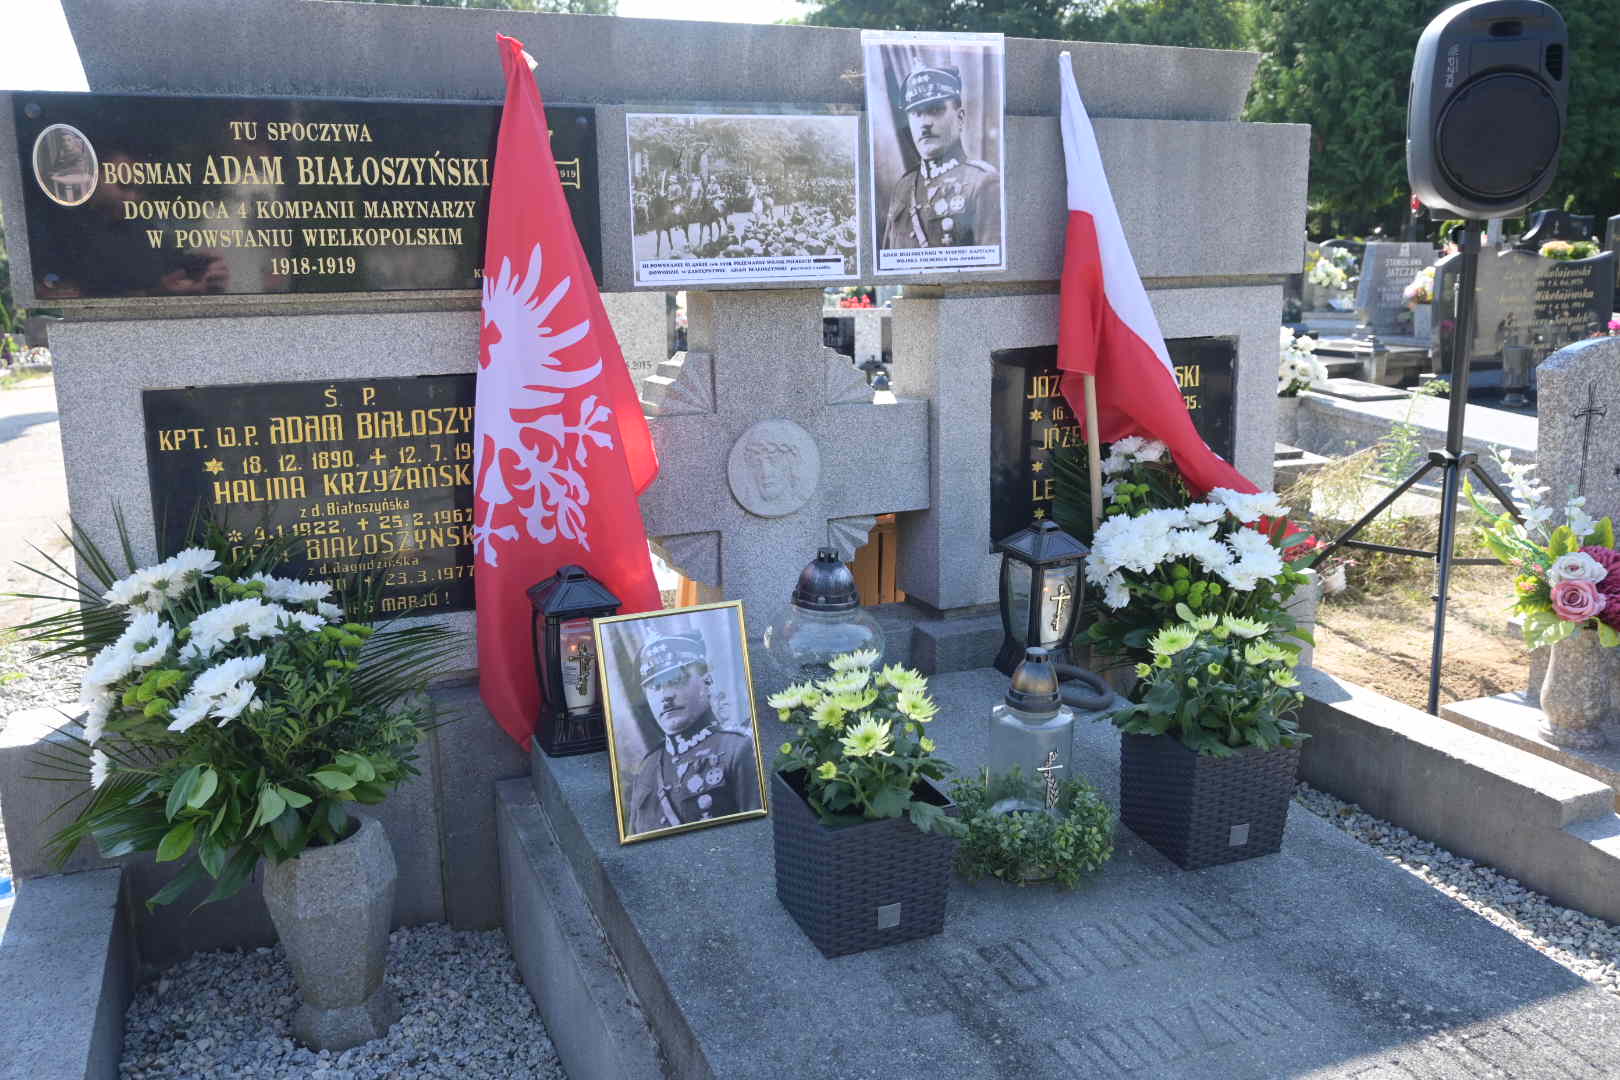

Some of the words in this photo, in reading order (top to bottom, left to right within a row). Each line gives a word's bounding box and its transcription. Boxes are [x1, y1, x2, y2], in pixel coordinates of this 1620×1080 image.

[229, 121, 258, 141] TU
[267, 122, 373, 142] SPOCZYWA
[102, 162, 192, 185] BOSMAN
[202, 154, 285, 185] ADAM
[296, 150, 490, 186] BIAŁOSZYŃSKI
[123, 195, 229, 220] DOWÓDCA
[238, 202, 249, 219] 4
[256, 200, 354, 219] KOMPANII
[363, 200, 476, 219] MARYNARZY
[146, 229, 164, 248] W
[175, 229, 293, 248] POWSTANIU
[302, 227, 464, 247] WIELKOPOLSKIM
[271, 256, 356, 275] 1918-1919
[323, 384, 343, 408] Ś.
[362, 386, 376, 406] P.
[159, 428, 208, 451] KPT.
[269, 414, 344, 445] ADAM
[356, 407, 472, 440] BIAŁOSZY
[243, 455, 268, 475] 18.
[279, 453, 304, 472] 12.
[311, 449, 360, 470] 1890.
[399, 445, 422, 464] 12.
[430, 443, 448, 462] 7.
[454, 442, 474, 461] 19
[212, 475, 306, 505] HALINA
[300, 507, 307, 518] z
